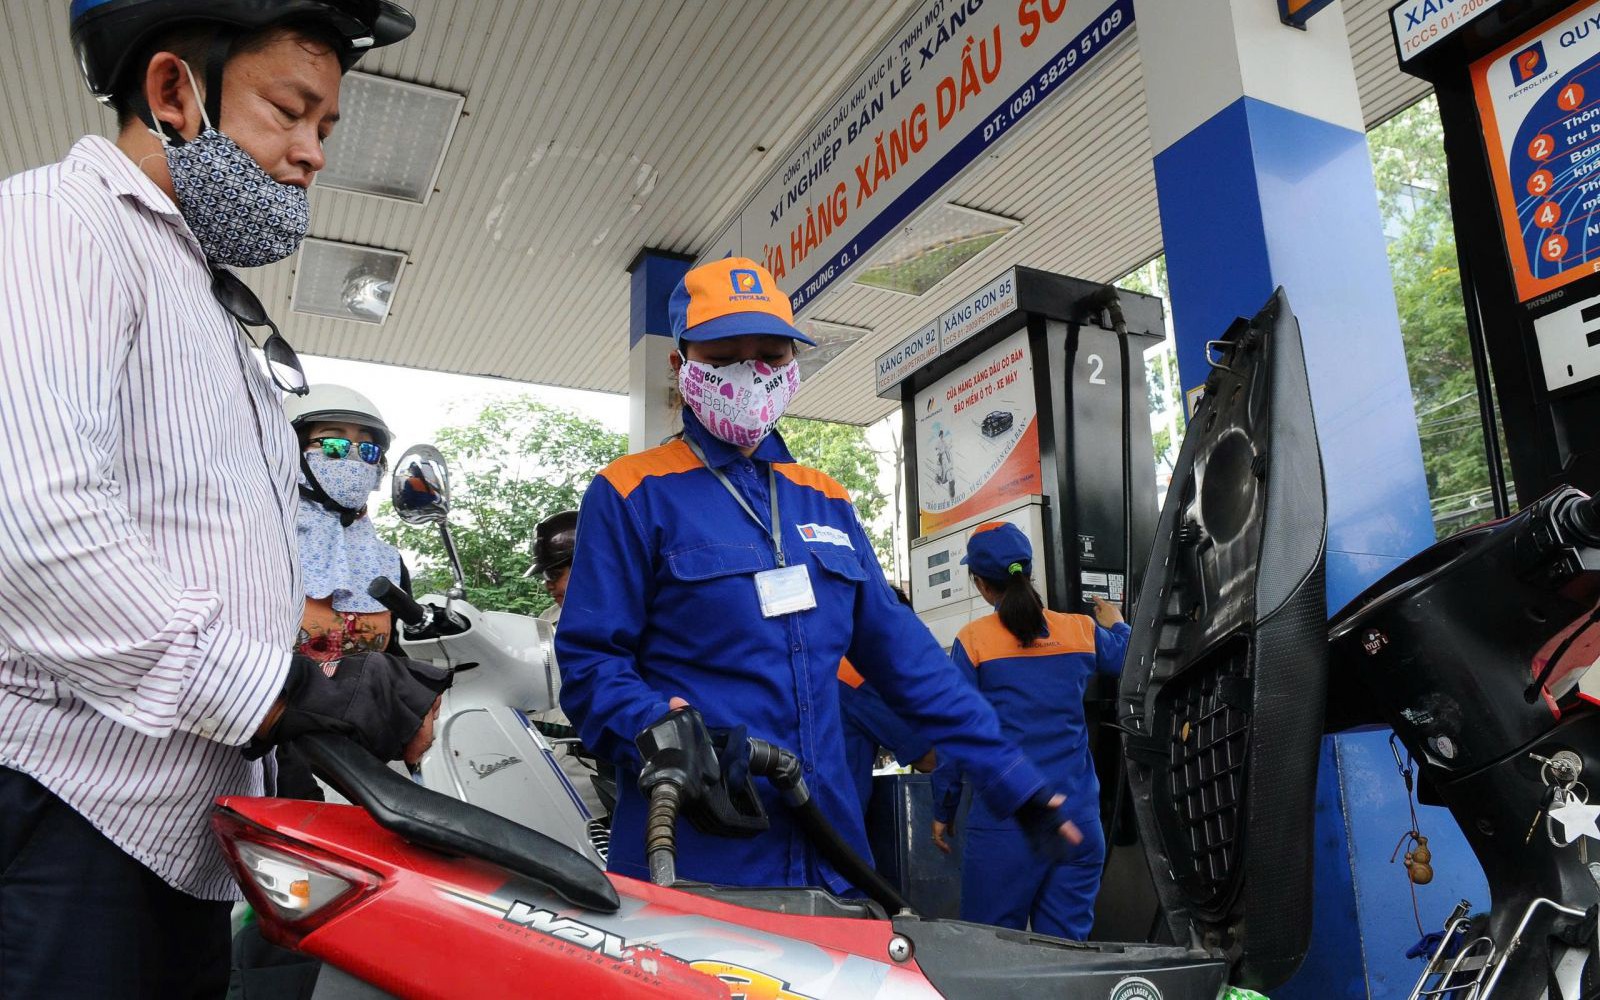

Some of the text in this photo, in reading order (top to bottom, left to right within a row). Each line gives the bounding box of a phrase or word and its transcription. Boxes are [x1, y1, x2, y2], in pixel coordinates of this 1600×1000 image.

[1404, 24, 1438, 52] TCCS
[983, 9, 1122, 142] ĐT: (08) 3829 5109
[1508, 70, 1560, 100] PETROLIMEX
[783, 158, 801, 186] CÔNG
[802, 146, 811, 165] TY
[850, 85, 867, 111] KHU
[868, 64, 885, 91] VỰC
[887, 55, 893, 72] II
[899, 21, 923, 56] TNHH
[1564, 88, 1576, 106] 1
[770, 194, 783, 229] XÍ
[787, 138, 842, 210] NGHIỆP
[847, 91, 884, 145] BÁN
[890, 57, 912, 100] LẺ
[790, 181, 848, 270] HÀNG
[855, 102, 928, 209] XĂNG
[936, 23, 1002, 131] DẦU
[1533, 138, 1548, 158] 2
[1567, 130, 1588, 145] trụ
[1532, 174, 1547, 193] 3
[1540, 205, 1554, 224] 4
[1548, 238, 1562, 258] 5
[792, 291, 804, 311] BÀ
[841, 253, 851, 267] Q.
[853, 243, 858, 256] 1
[944, 279, 1011, 333] XĂNG RON 95
[1525, 290, 1565, 310] TATSUNO
[880, 328, 936, 376] XĂNG RON 92
[704, 371, 723, 386] BOY
[1088, 354, 1106, 385] 2
[765, 374, 783, 393] BABY
[996, 378, 1005, 391] XE
[702, 389, 740, 422] Baby
[497, 923, 531, 938] CITY
